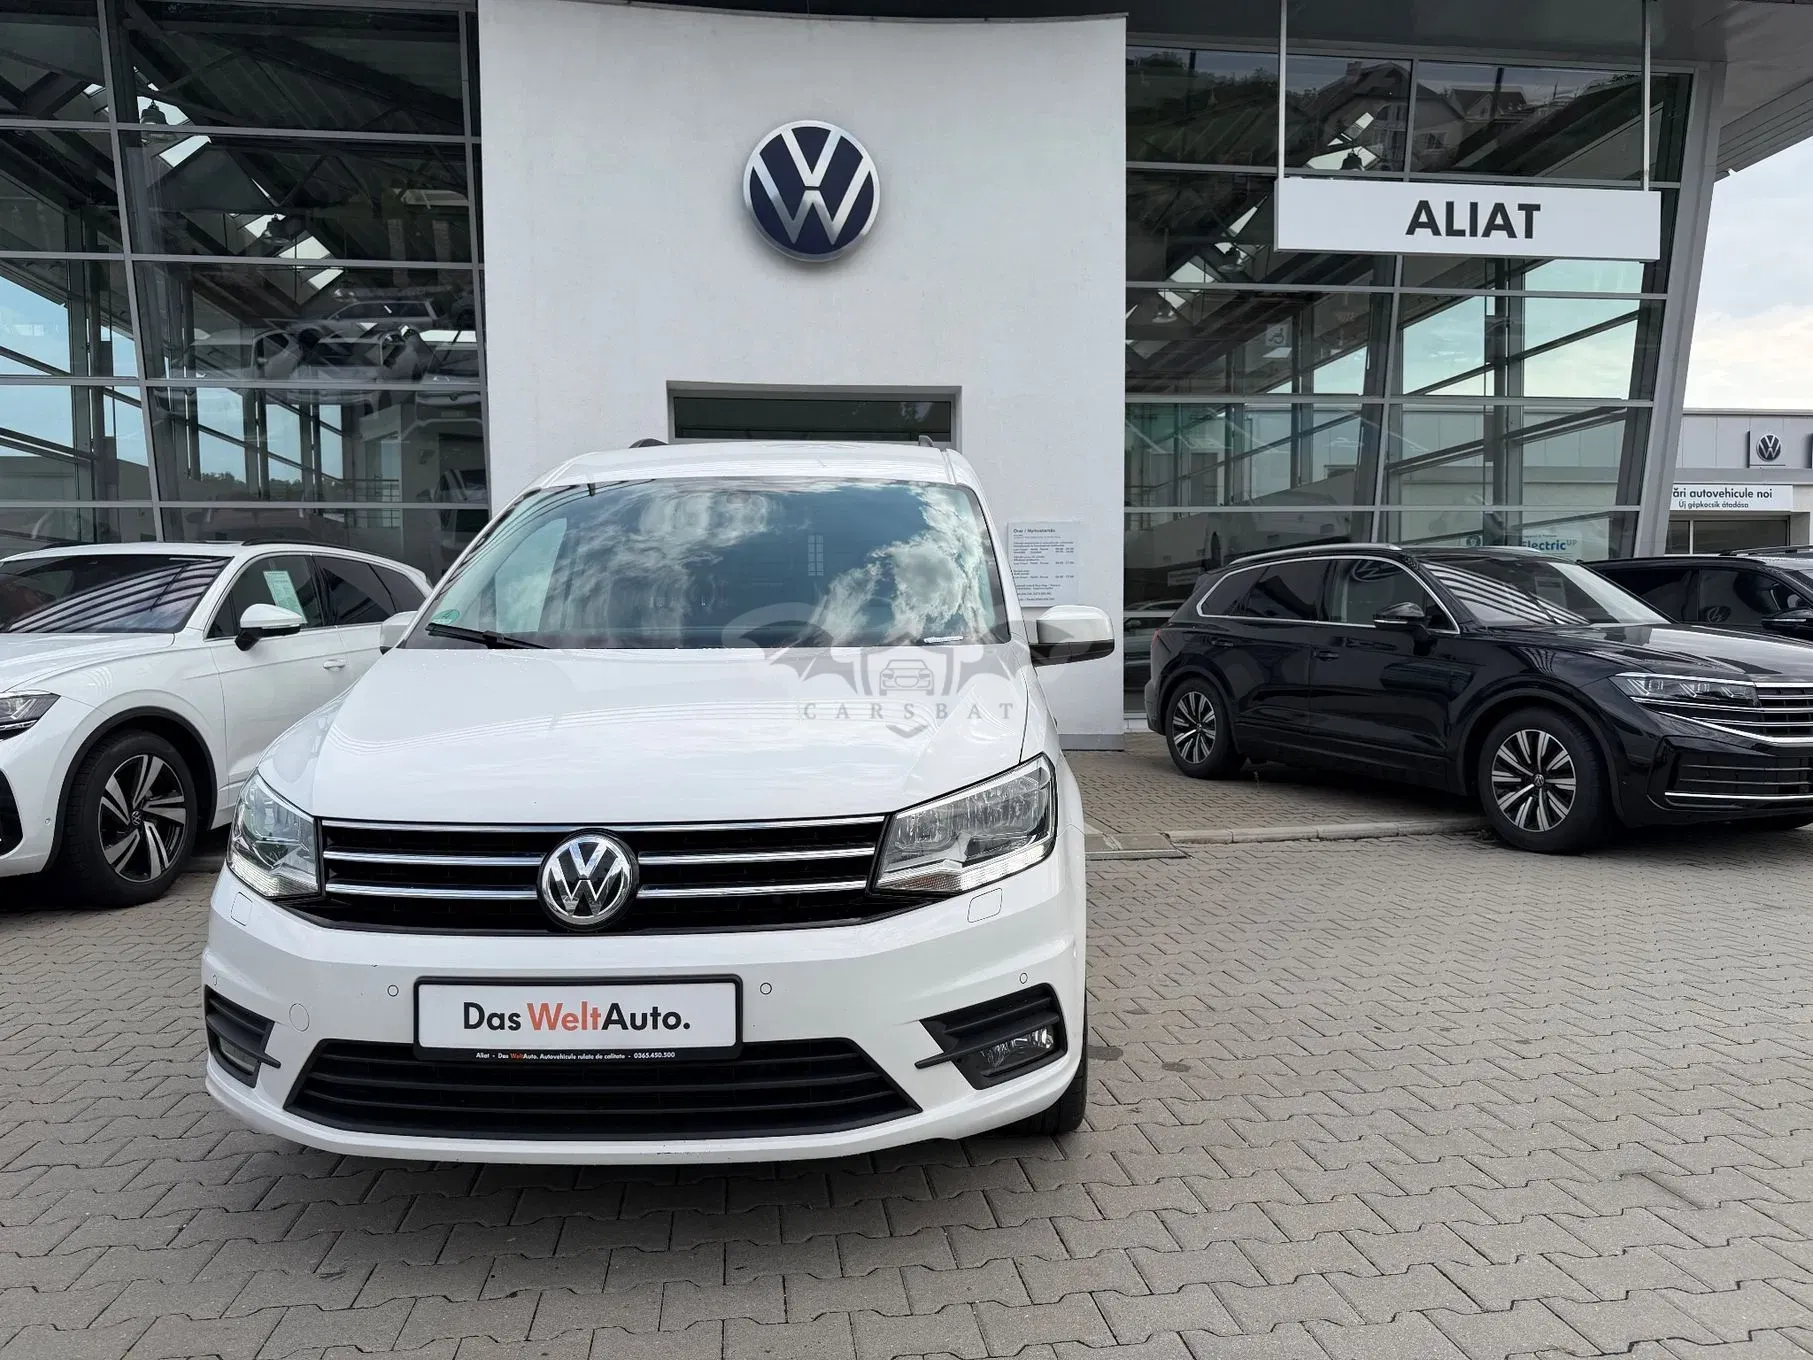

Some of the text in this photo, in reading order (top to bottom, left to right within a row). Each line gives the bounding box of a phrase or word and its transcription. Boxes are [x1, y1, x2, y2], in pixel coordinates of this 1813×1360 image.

[743, 120, 880, 262] VW
[1405, 200, 1541, 239] ALIAT
[1756, 434, 1781, 462] VW
[1688, 501, 1720, 509] gépkocsik
[1690, 488, 1754, 498] autovehicule
[1756, 489, 1772, 498] noi
[541, 834, 631, 925] VW
[463, 1001, 691, 1031] Das WeltAuto.
